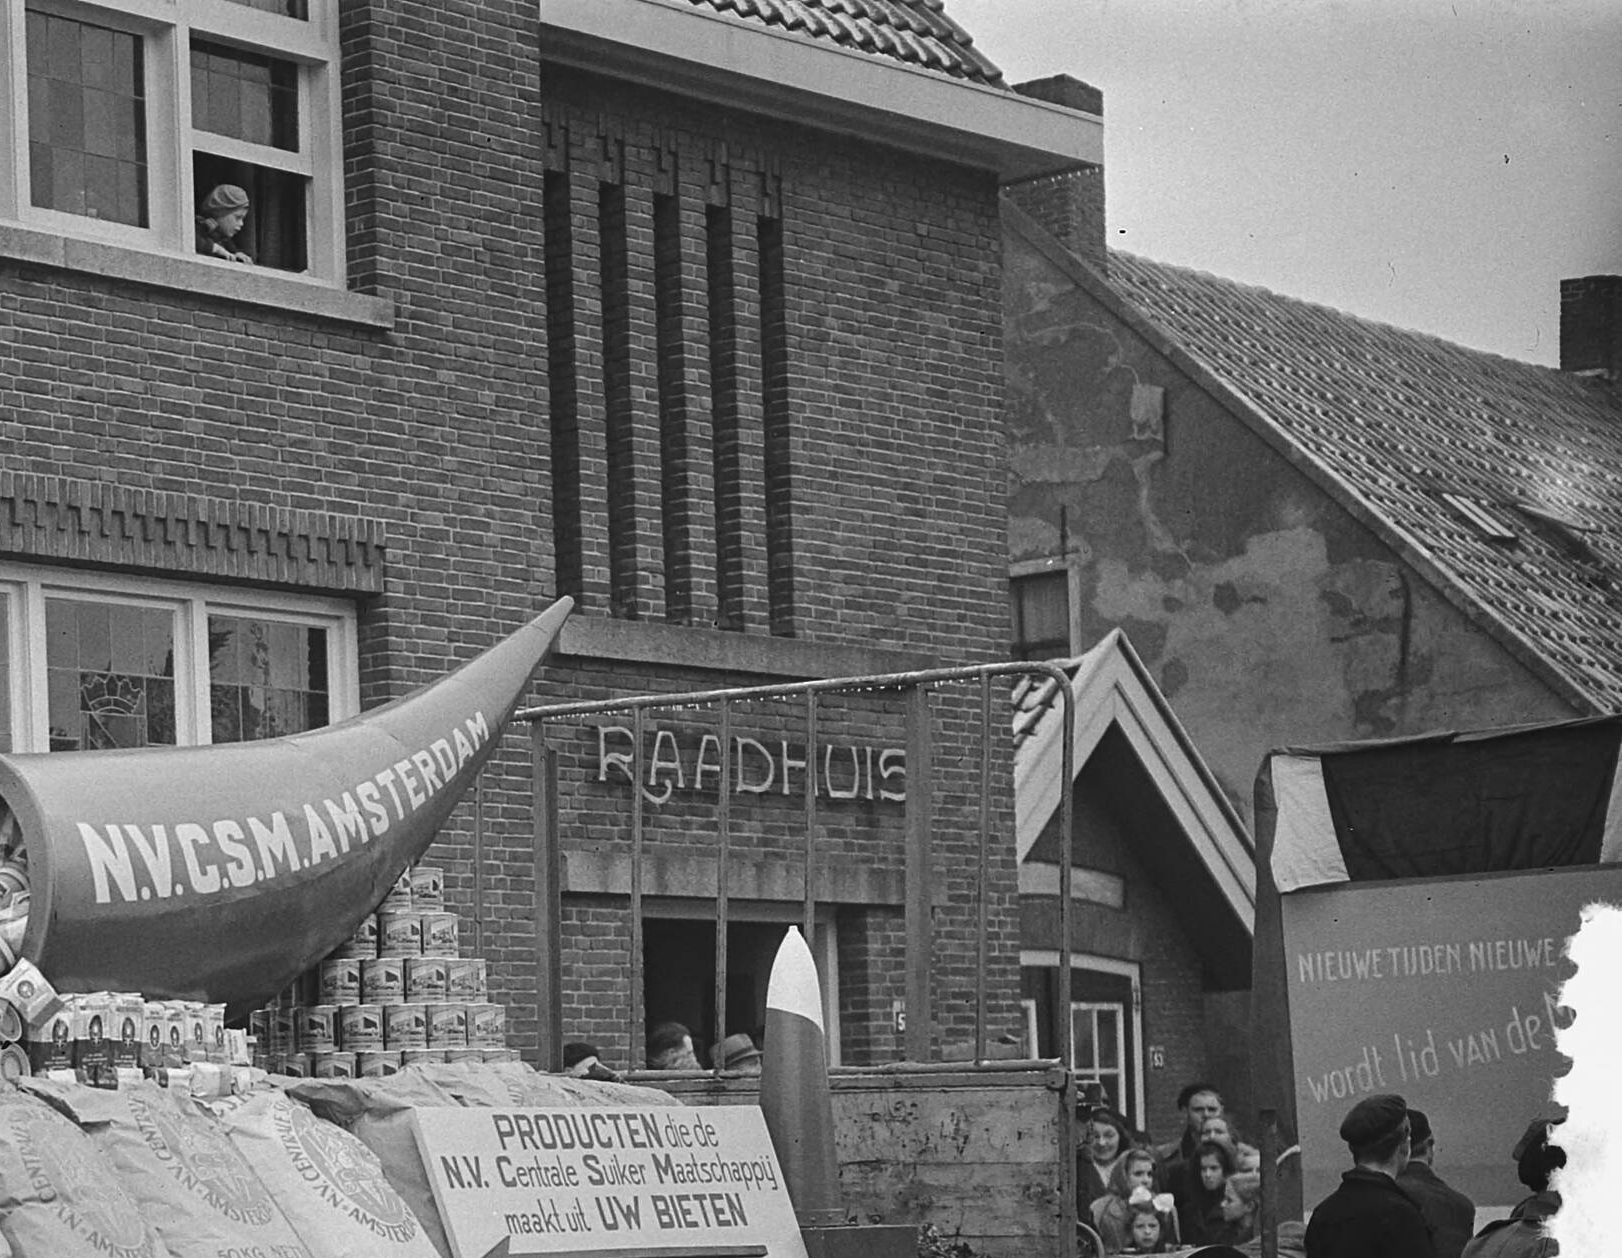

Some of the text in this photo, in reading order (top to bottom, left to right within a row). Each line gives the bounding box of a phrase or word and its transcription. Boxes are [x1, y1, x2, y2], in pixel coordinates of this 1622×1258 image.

[597, 725, 907, 804] RAADHUIS
[304, 711, 491, 864] AMSTERDAM
[1298, 938, 1556, 983] NIEUWE TIJDEN NIEUWE
[1308, 1047, 1387, 1104] wordt
[1394, 1030, 1441, 1083] lid
[1506, 1006, 1542, 1055] de
[492, 1112, 719, 1151] PRODUCTEN die de
[440, 1153, 779, 1192] N.V. Centrale Suiker Maatschappij
[505, 1193, 749, 1236] maakt uit UW BIETEN
